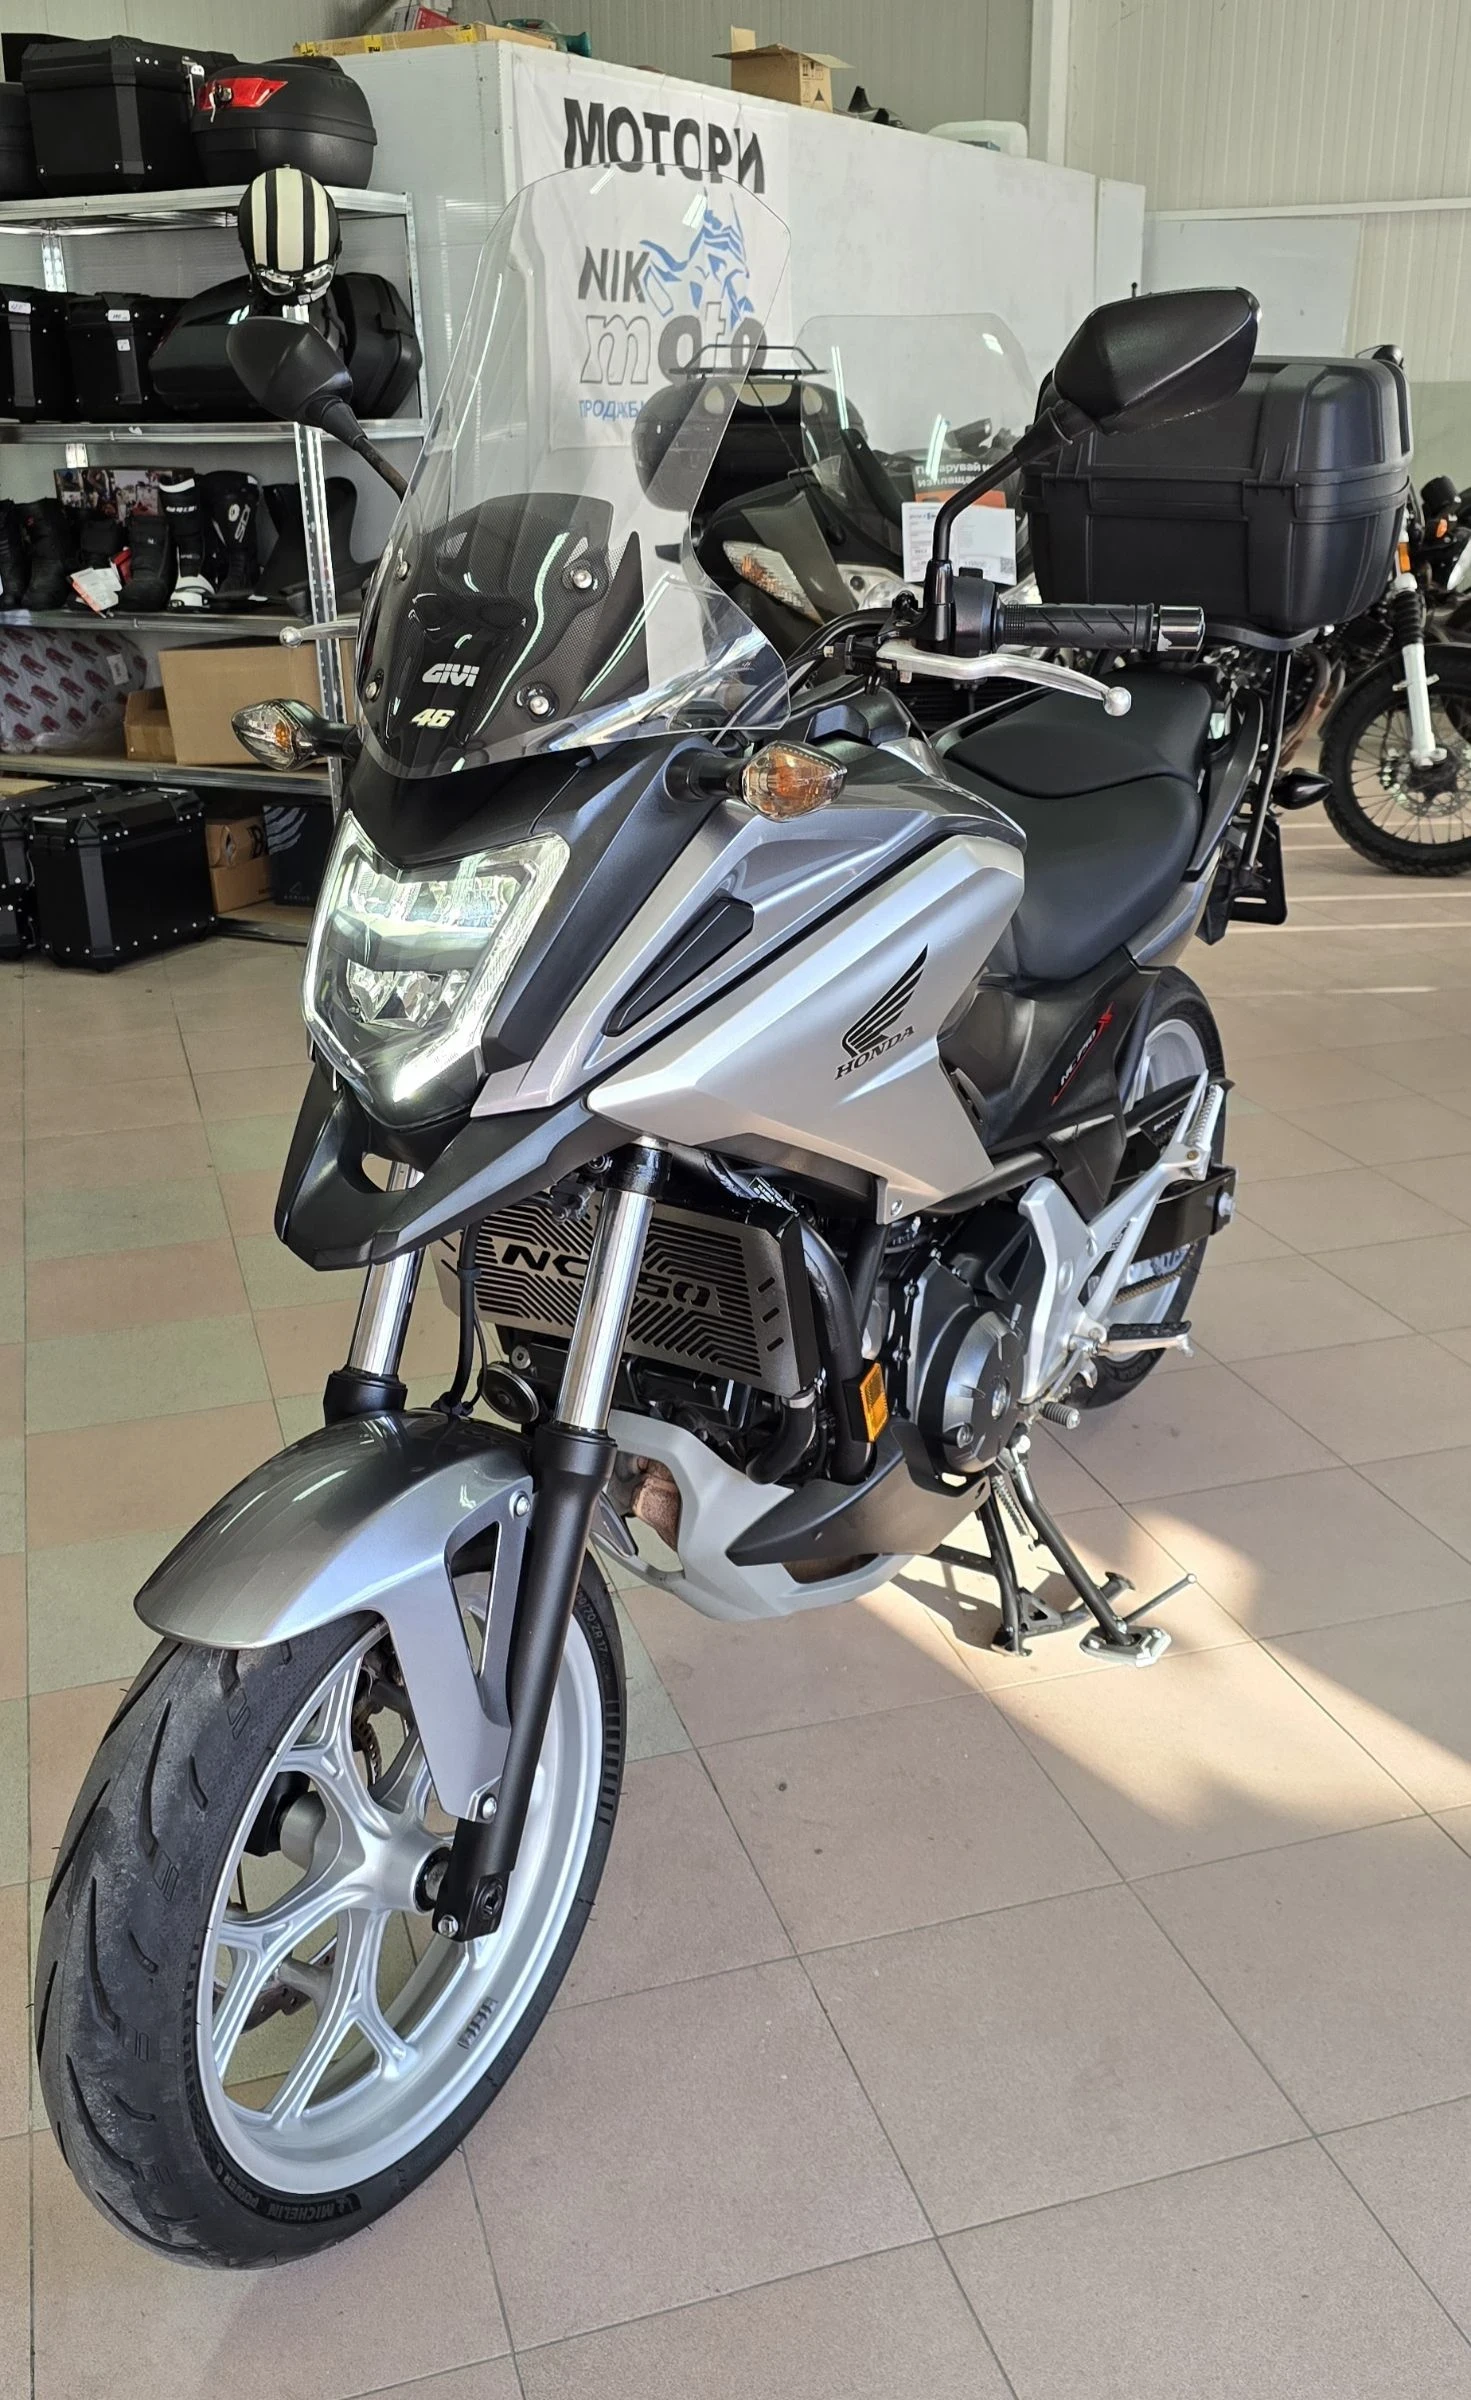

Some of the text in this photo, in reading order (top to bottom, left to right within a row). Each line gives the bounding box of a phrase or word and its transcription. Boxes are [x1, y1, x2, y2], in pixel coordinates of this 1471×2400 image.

[563, 97, 765, 194] МОТОРИ
[578, 246, 650, 303] NIK
[422, 663, 480, 687] GIVI
[411, 708, 456, 729] 46
[834, 1025, 915, 1081] HONDA
[502, 1244, 711, 1308] NC50
[268, 2202, 335, 2221] MICHELIN
